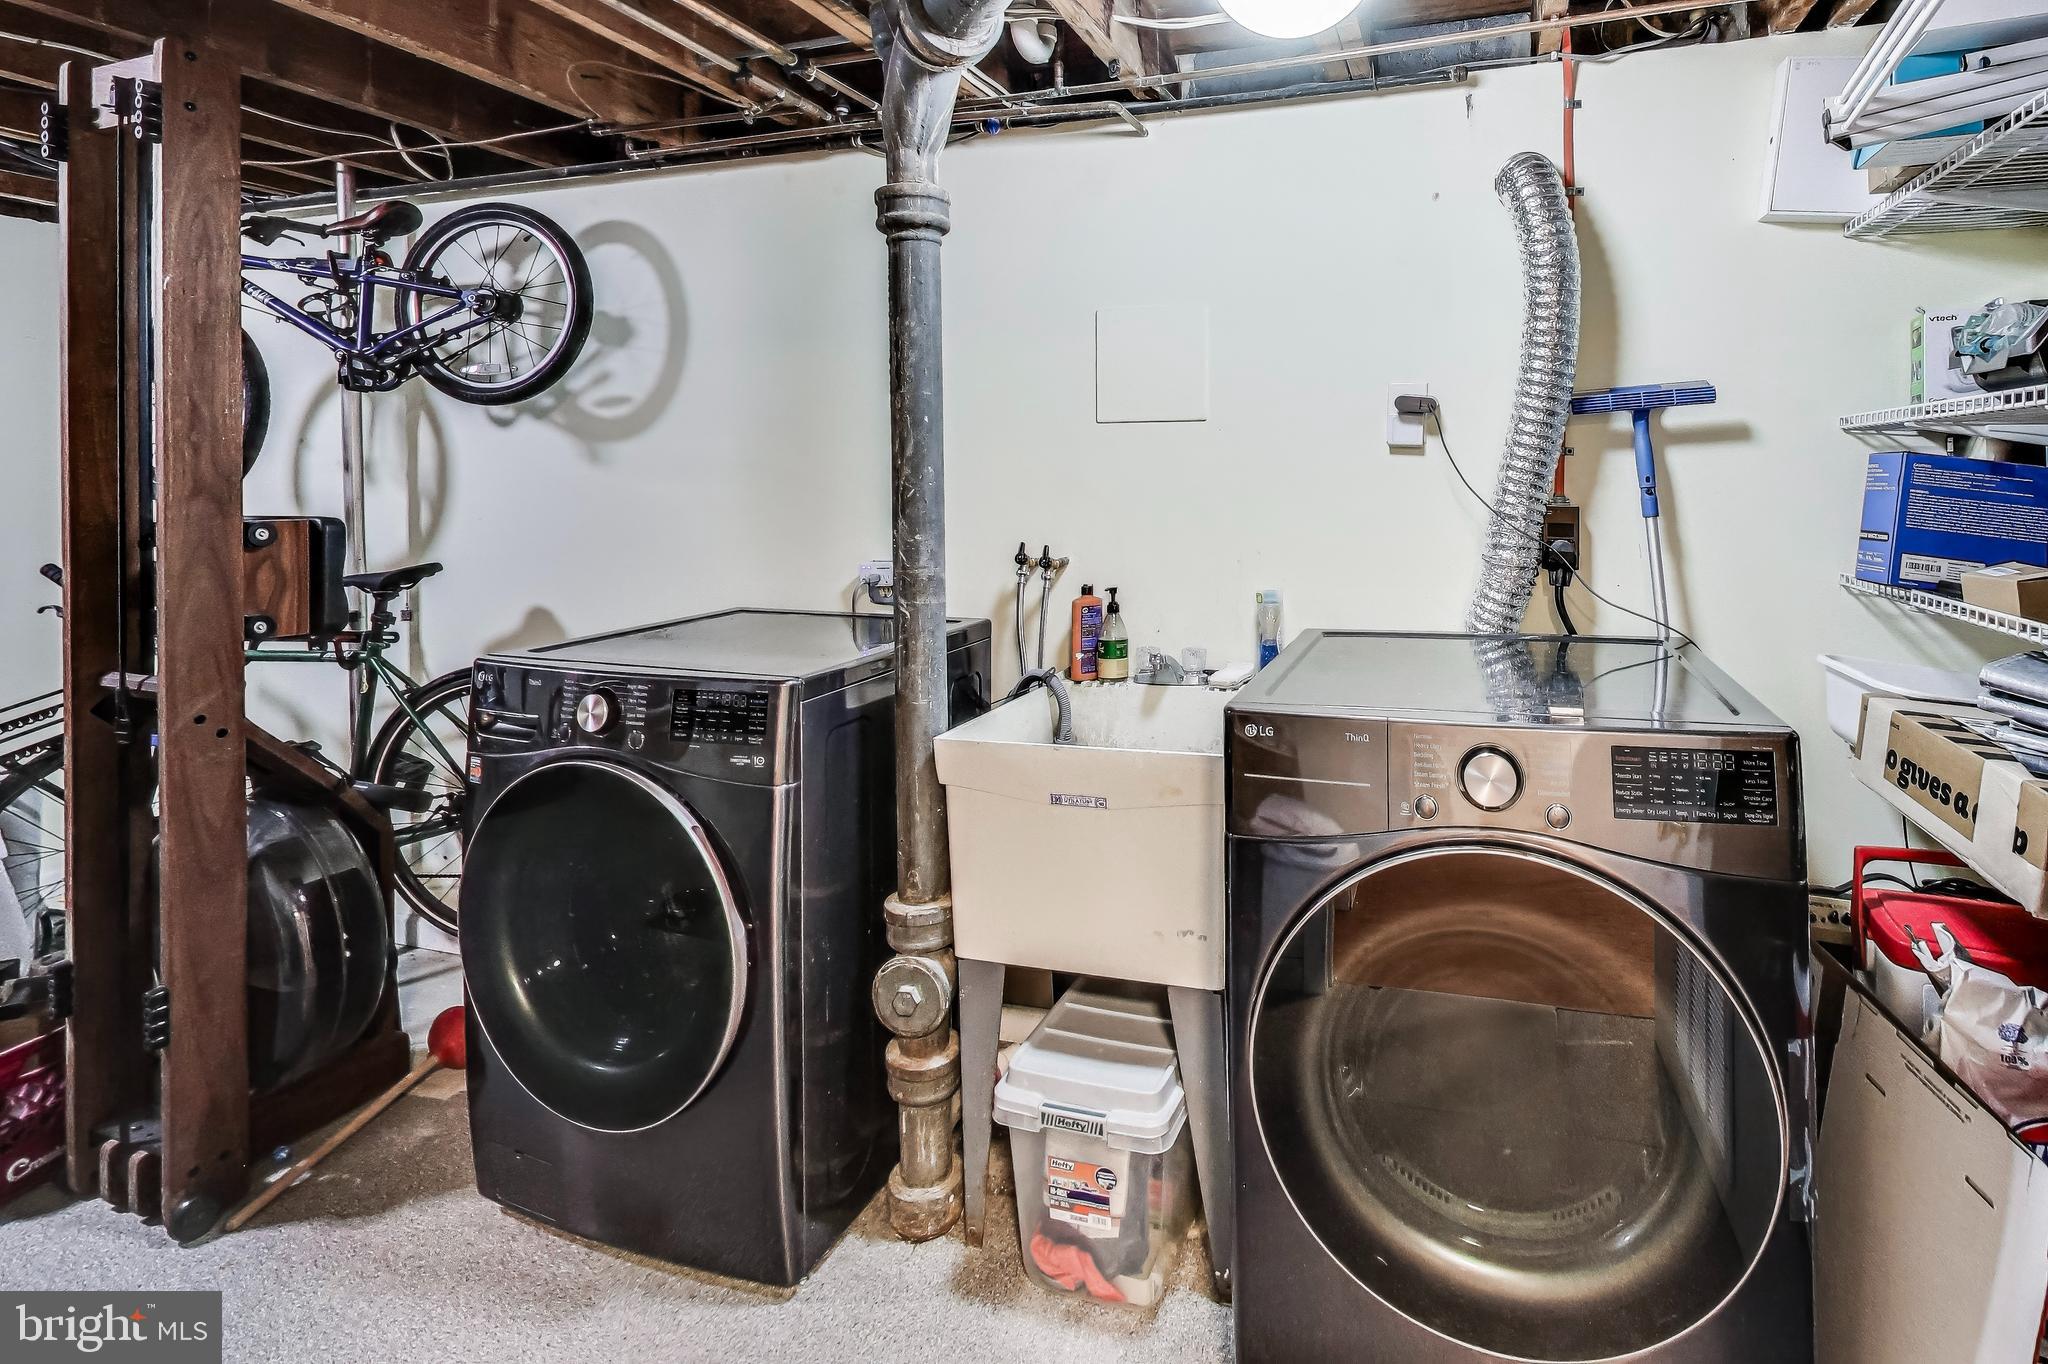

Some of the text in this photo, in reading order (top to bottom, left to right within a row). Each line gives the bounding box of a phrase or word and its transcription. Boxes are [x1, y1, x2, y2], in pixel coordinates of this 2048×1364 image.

[1929, 314, 1957, 322] vtech
[1260, 725, 1274, 737] LG
[1345, 732, 1370, 743] ThinQ
[1953, 791, 1969, 819] a
[1056, 1115, 1087, 1132] Hefty
[1051, 1160, 1073, 1171] Hefty
